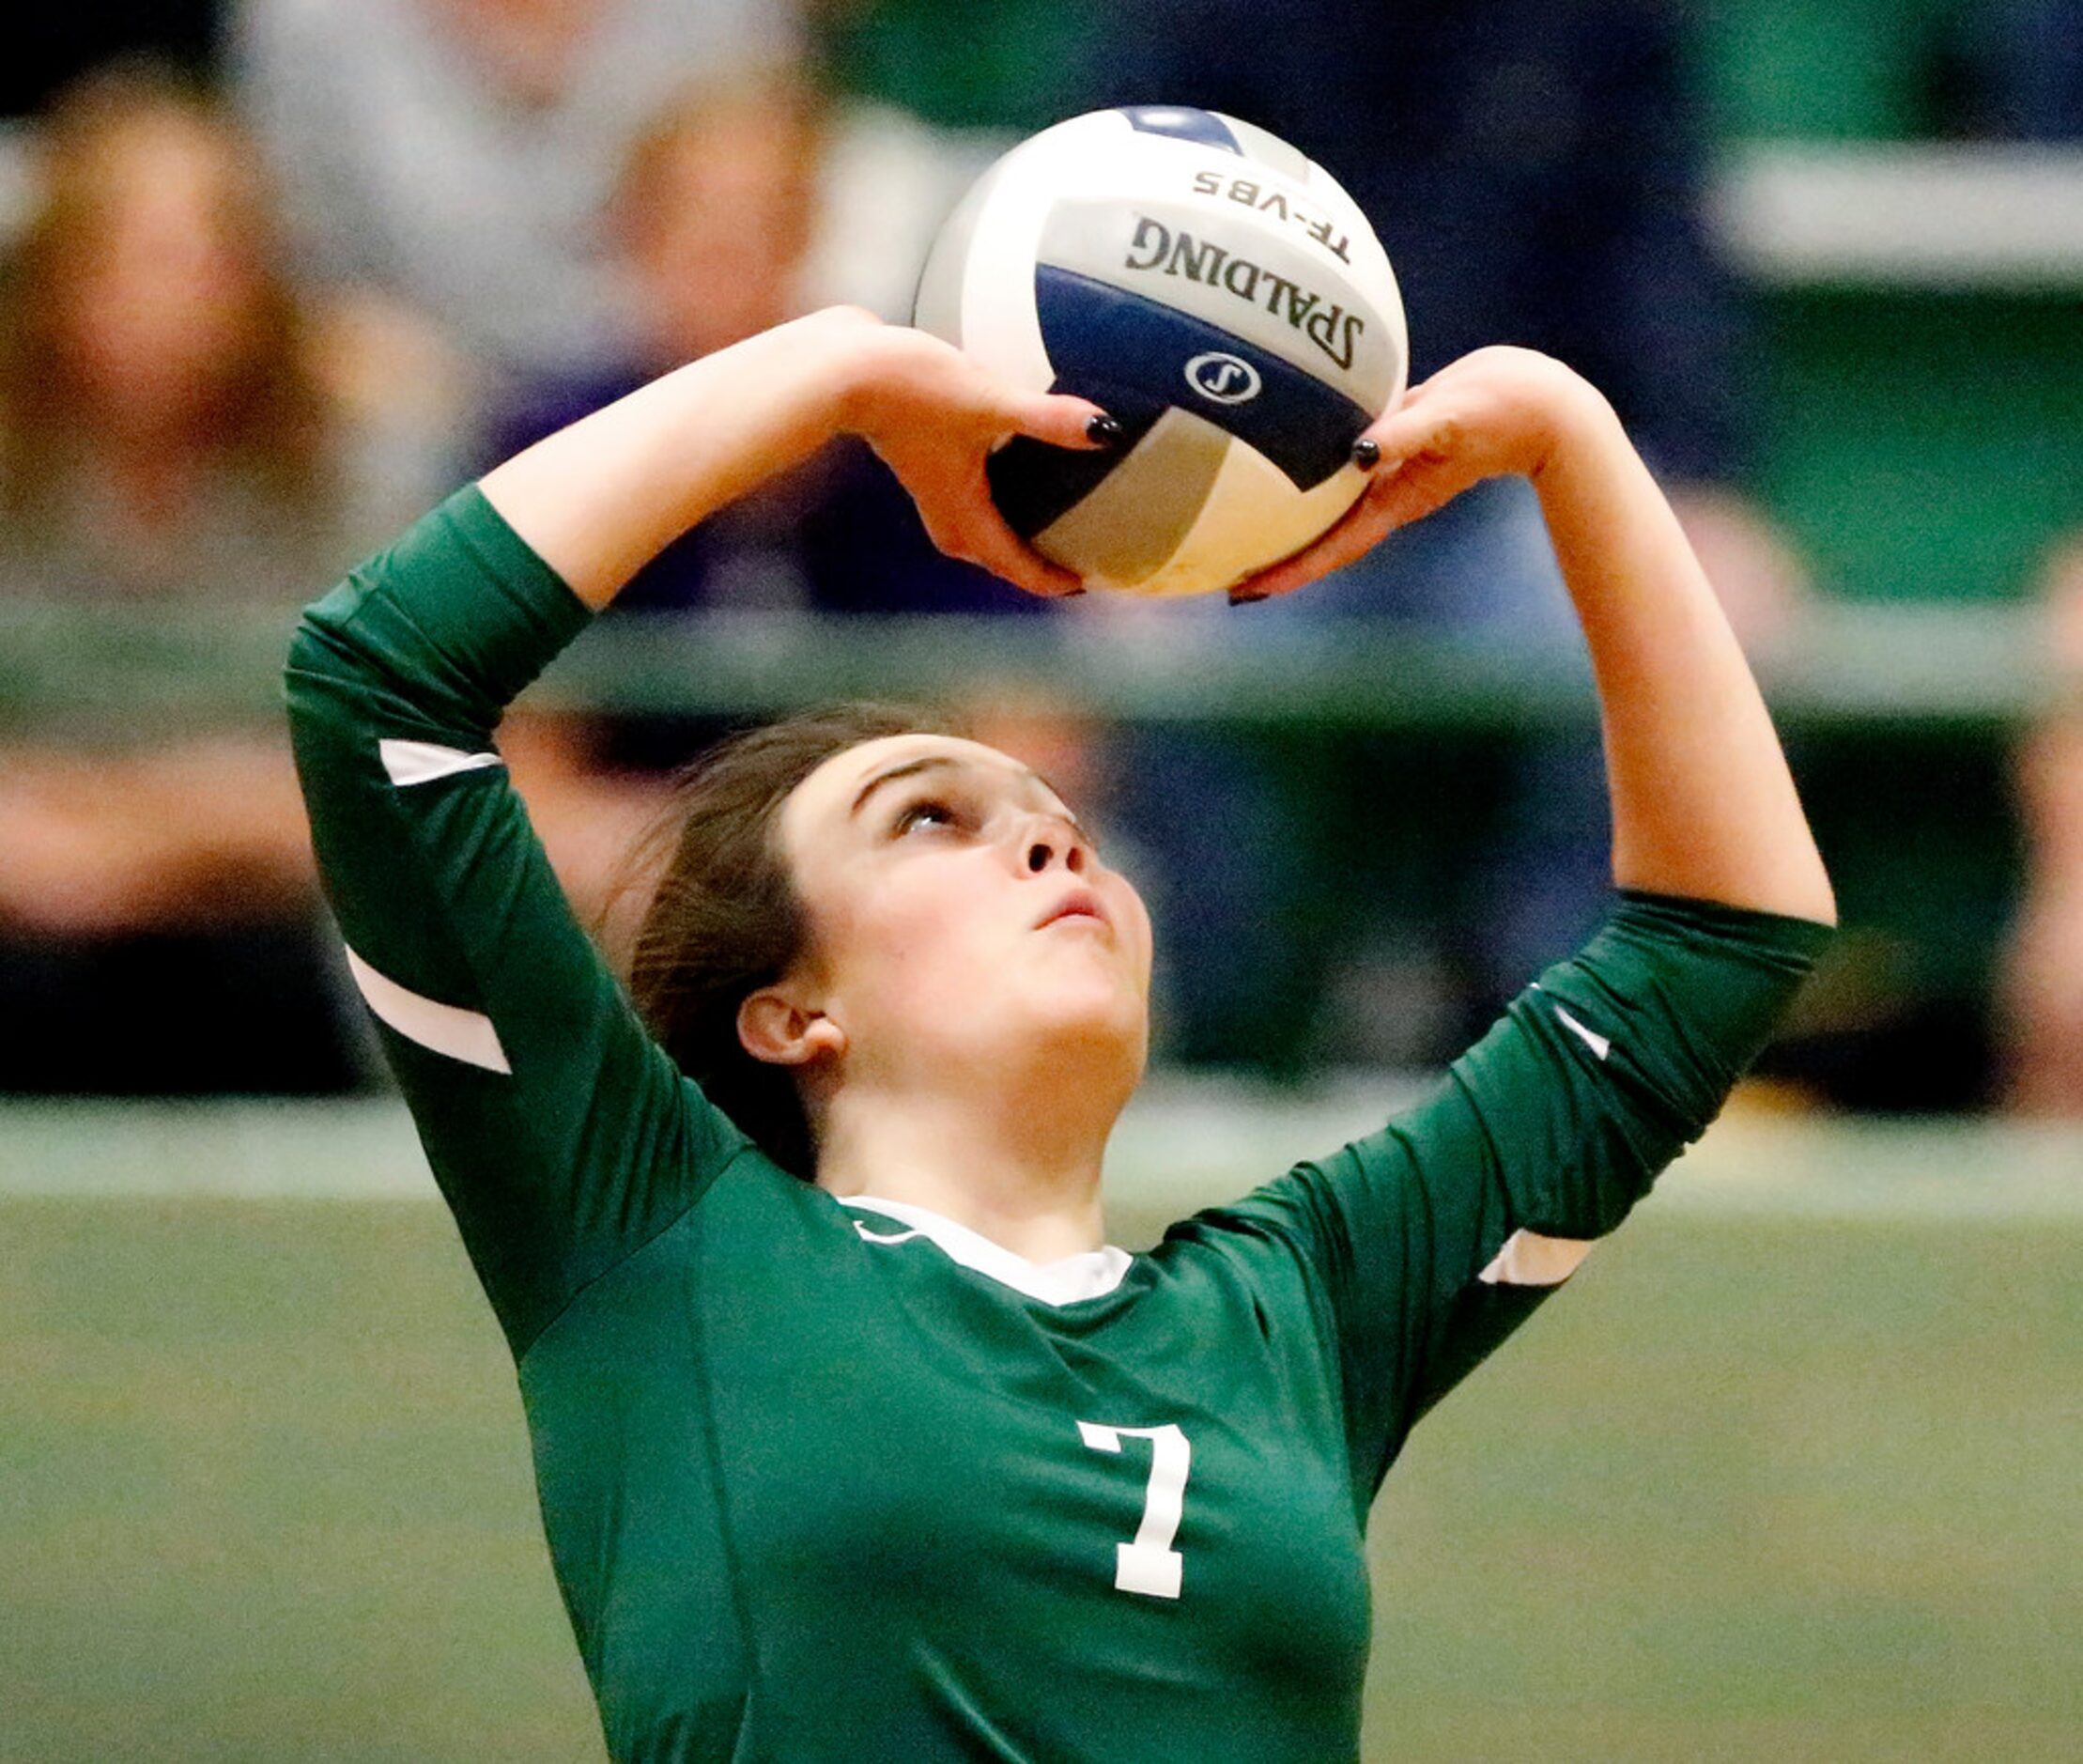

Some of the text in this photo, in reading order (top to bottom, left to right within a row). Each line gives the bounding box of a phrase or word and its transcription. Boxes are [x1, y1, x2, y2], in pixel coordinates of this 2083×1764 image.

[1126, 217, 1365, 370] SPALDING
[1194, 172, 1350, 264] TF-VB5
[1076, 1420, 1191, 1599] 7
